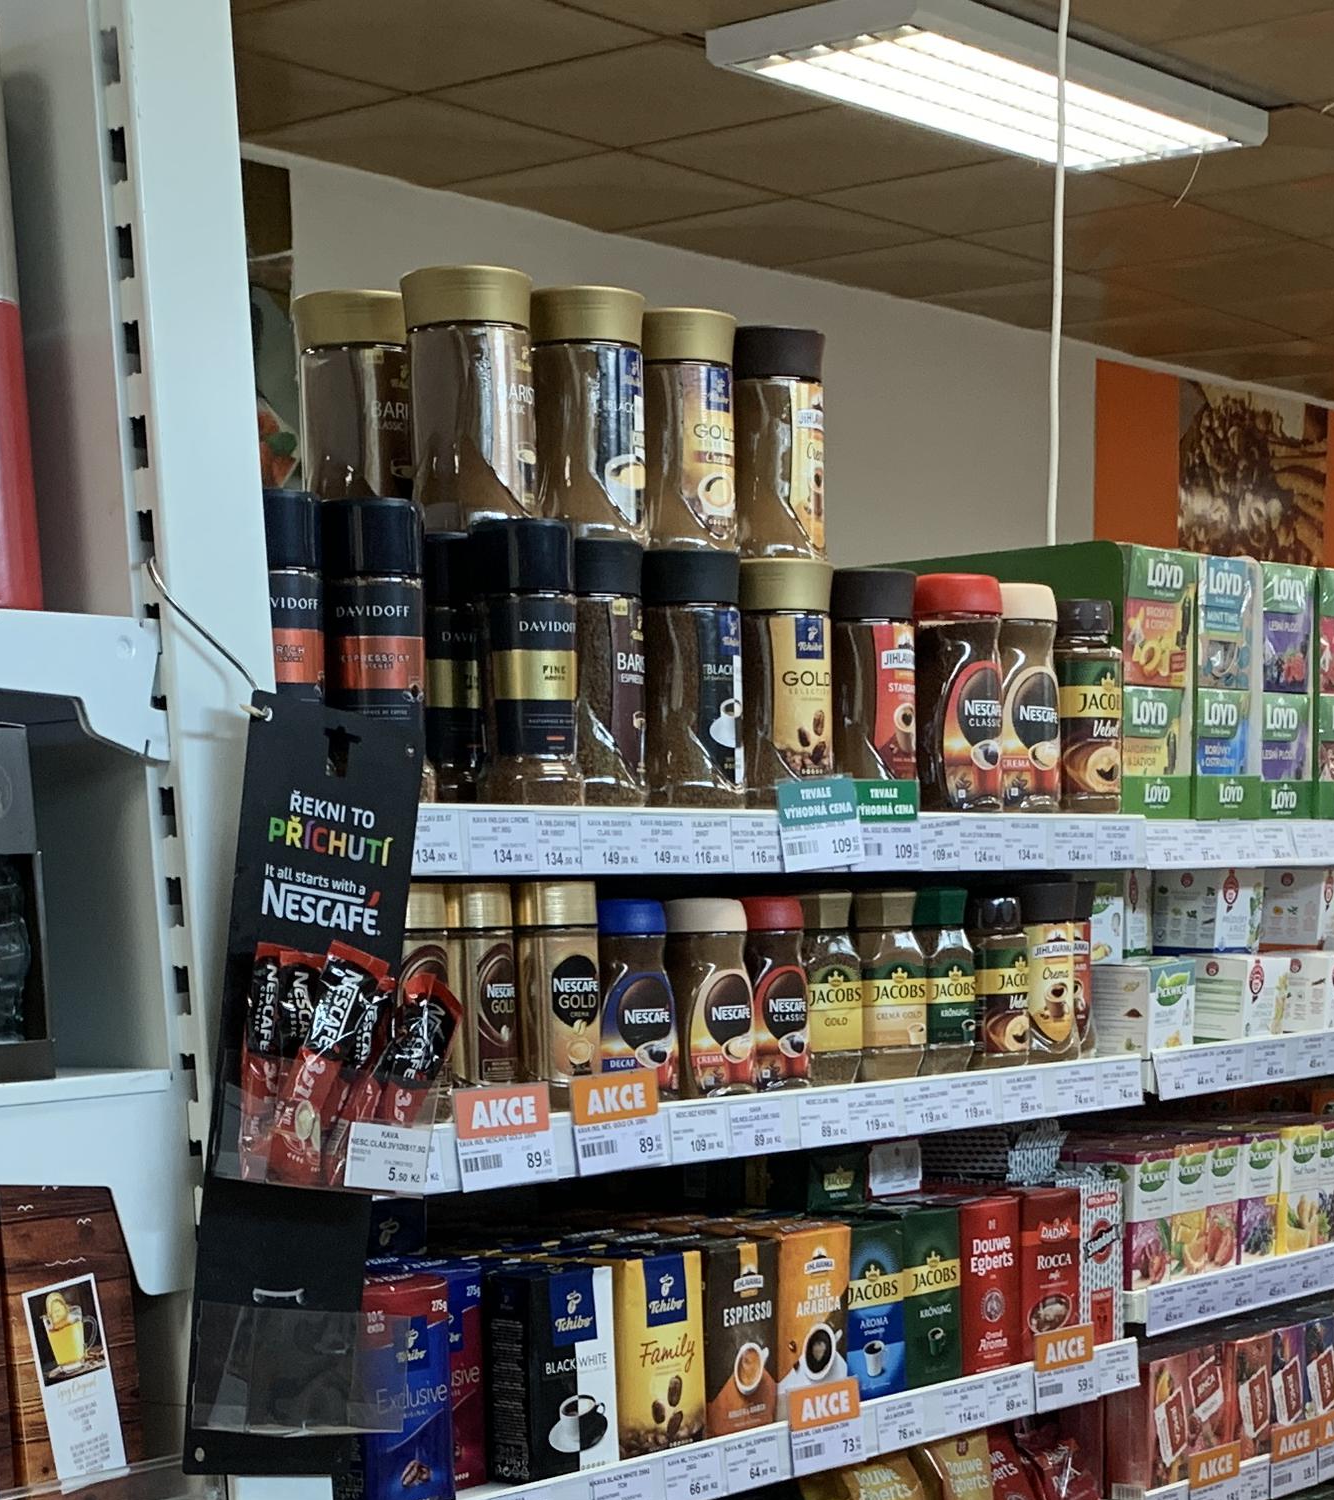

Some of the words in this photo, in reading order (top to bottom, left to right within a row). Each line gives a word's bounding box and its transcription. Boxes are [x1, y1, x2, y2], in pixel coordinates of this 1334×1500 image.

[1147, 558, 1184, 589] LOYD
[1209, 564, 1242, 596] LOYD
[1274, 573, 1305, 602] LOYD
[335, 606, 410, 618] DAVIDOFF
[782, 670, 831, 687] GOLD
[1132, 698, 1167, 729] LOYD
[1204, 697, 1238, 728] LOYD
[1266, 701, 1298, 730] LOYD
[800, 786, 832, 800] TRVALE
[869, 787, 898, 800] TRVALE
[289, 789, 346, 823] ŘEKNI
[351, 807, 375, 829] TO
[784, 802, 827, 821] VÝHODNÁ
[828, 801, 854, 815] CENA
[894, 804, 915, 816] CENA
[268, 815, 395, 867] PŘÍCHUTÍ
[265, 864, 274, 877] It
[276, 866, 293, 881] all
[295, 868, 329, 888] starts
[331, 878, 354, 894] with
[355, 885, 366, 896] a
[809, 987, 861, 1006] JACOBS
[873, 983, 926, 1002] JACOBS
[932, 982, 975, 1000] JACOBS
[559, 995, 596, 1010] GOLD
[773, 1013, 806, 1023] CLASSIC
[825, 1016, 848, 1027] GOLD
[609, 1059, 635, 1069] DECAF
[588, 1082, 645, 1116] AKCE
[471, 1096, 536, 1130] AKCE
[972, 1235, 1011, 1254] Douwe
[970, 1252, 1013, 1276] Egberts
[1037, 1254, 1072, 1270] ROCCA
[913, 1265, 957, 1291] JACOBS
[807, 1284, 831, 1299] CAFÉ
[848, 1280, 898, 1305] JACOBS
[431, 1299, 448, 1313] 275g
[648, 1298, 685, 1315] Tchibo
[723, 1300, 772, 1327] ESPRESSO
[796, 1297, 841, 1318] ARABICA
[919, 1305, 951, 1319] KRÖNUNG
[555, 1312, 594, 1333] Tchibo
[860, 1317, 889, 1329] AROMA
[640, 1333, 695, 1373] Family
[978, 1338, 1008, 1352] Aroma
[1045, 1336, 1086, 1364] AKCE
[545, 1358, 577, 1376] BLACK
[578, 1352, 608, 1369] WHITE
[375, 1379, 448, 1414] Exclusive
[801, 1391, 850, 1421] AKCE
[1279, 1428, 1310, 1452] AKCE
[1198, 1455, 1233, 1479] AKCE
